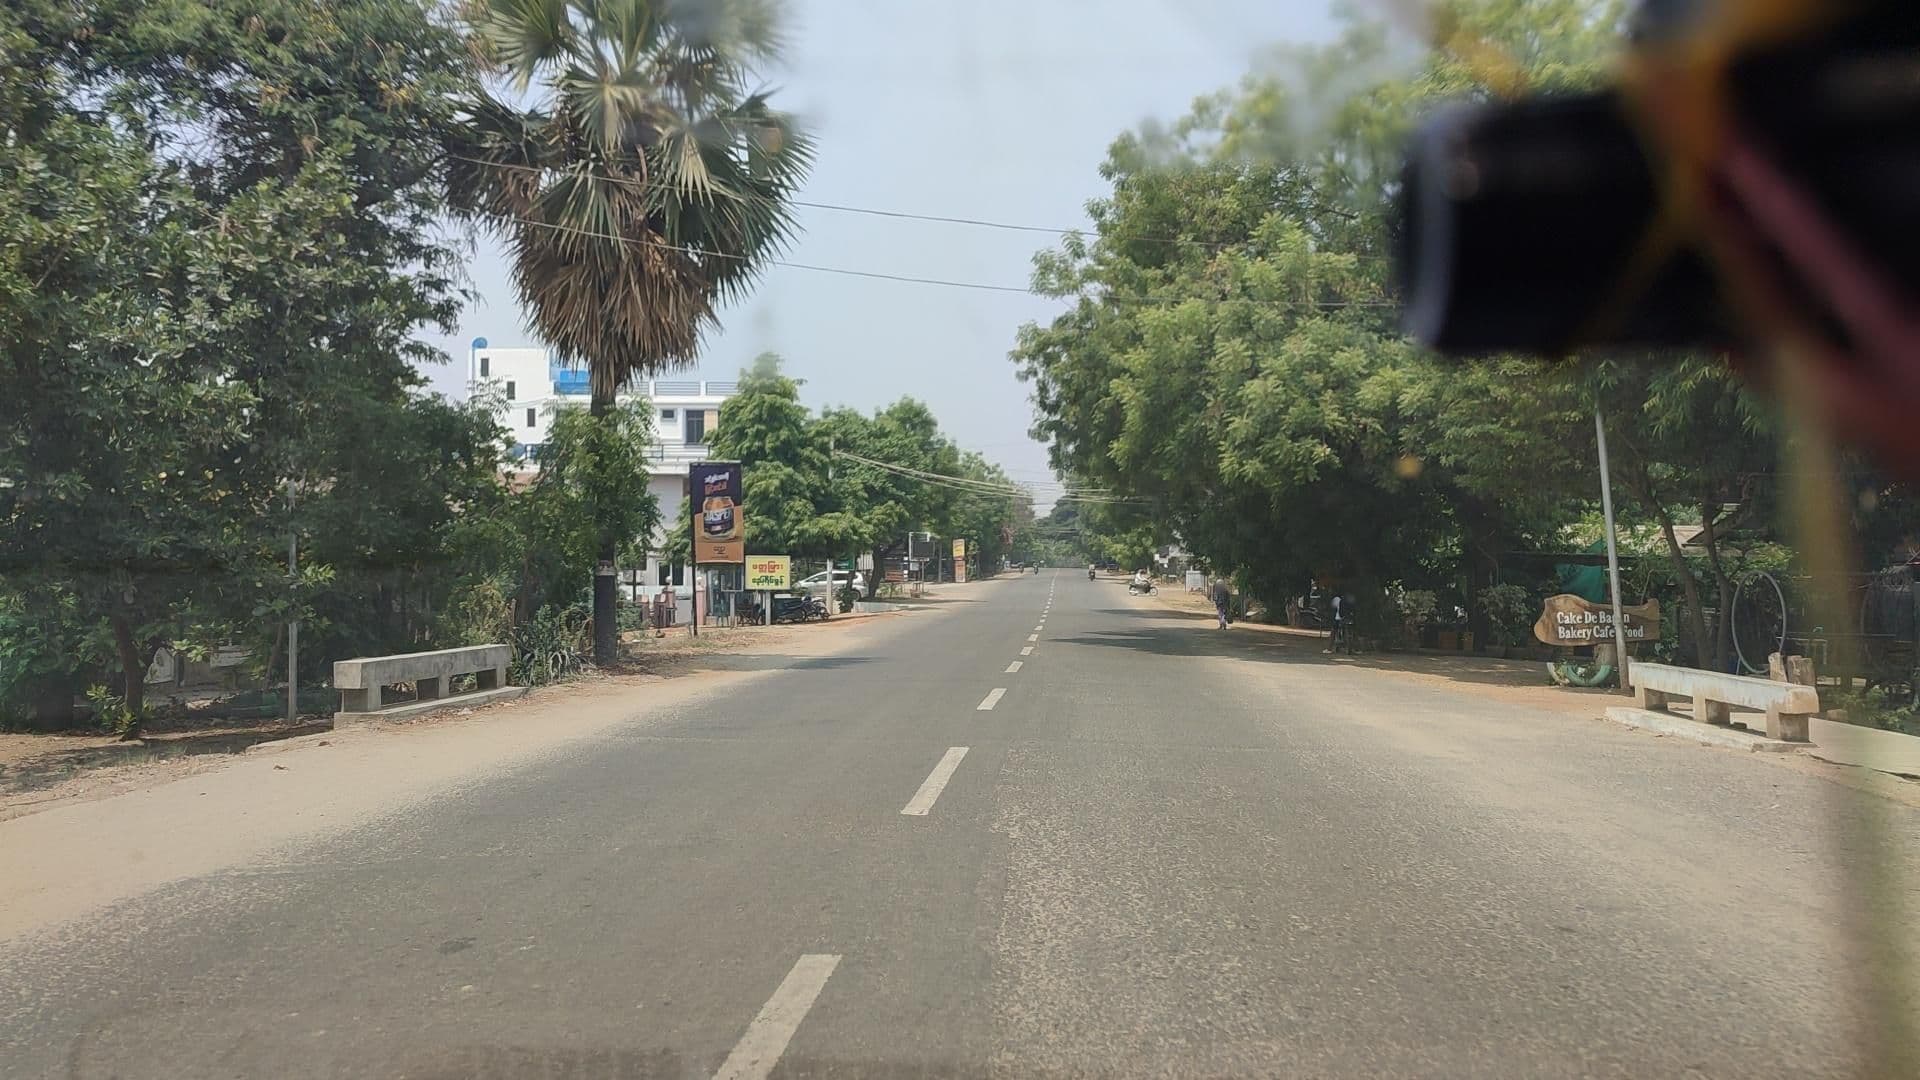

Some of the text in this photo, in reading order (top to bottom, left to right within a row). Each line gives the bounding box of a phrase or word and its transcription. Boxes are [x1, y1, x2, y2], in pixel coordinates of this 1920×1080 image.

[1557, 611, 1630, 626] Cake De Bagn
[1558, 626, 1592, 641] Bakery
